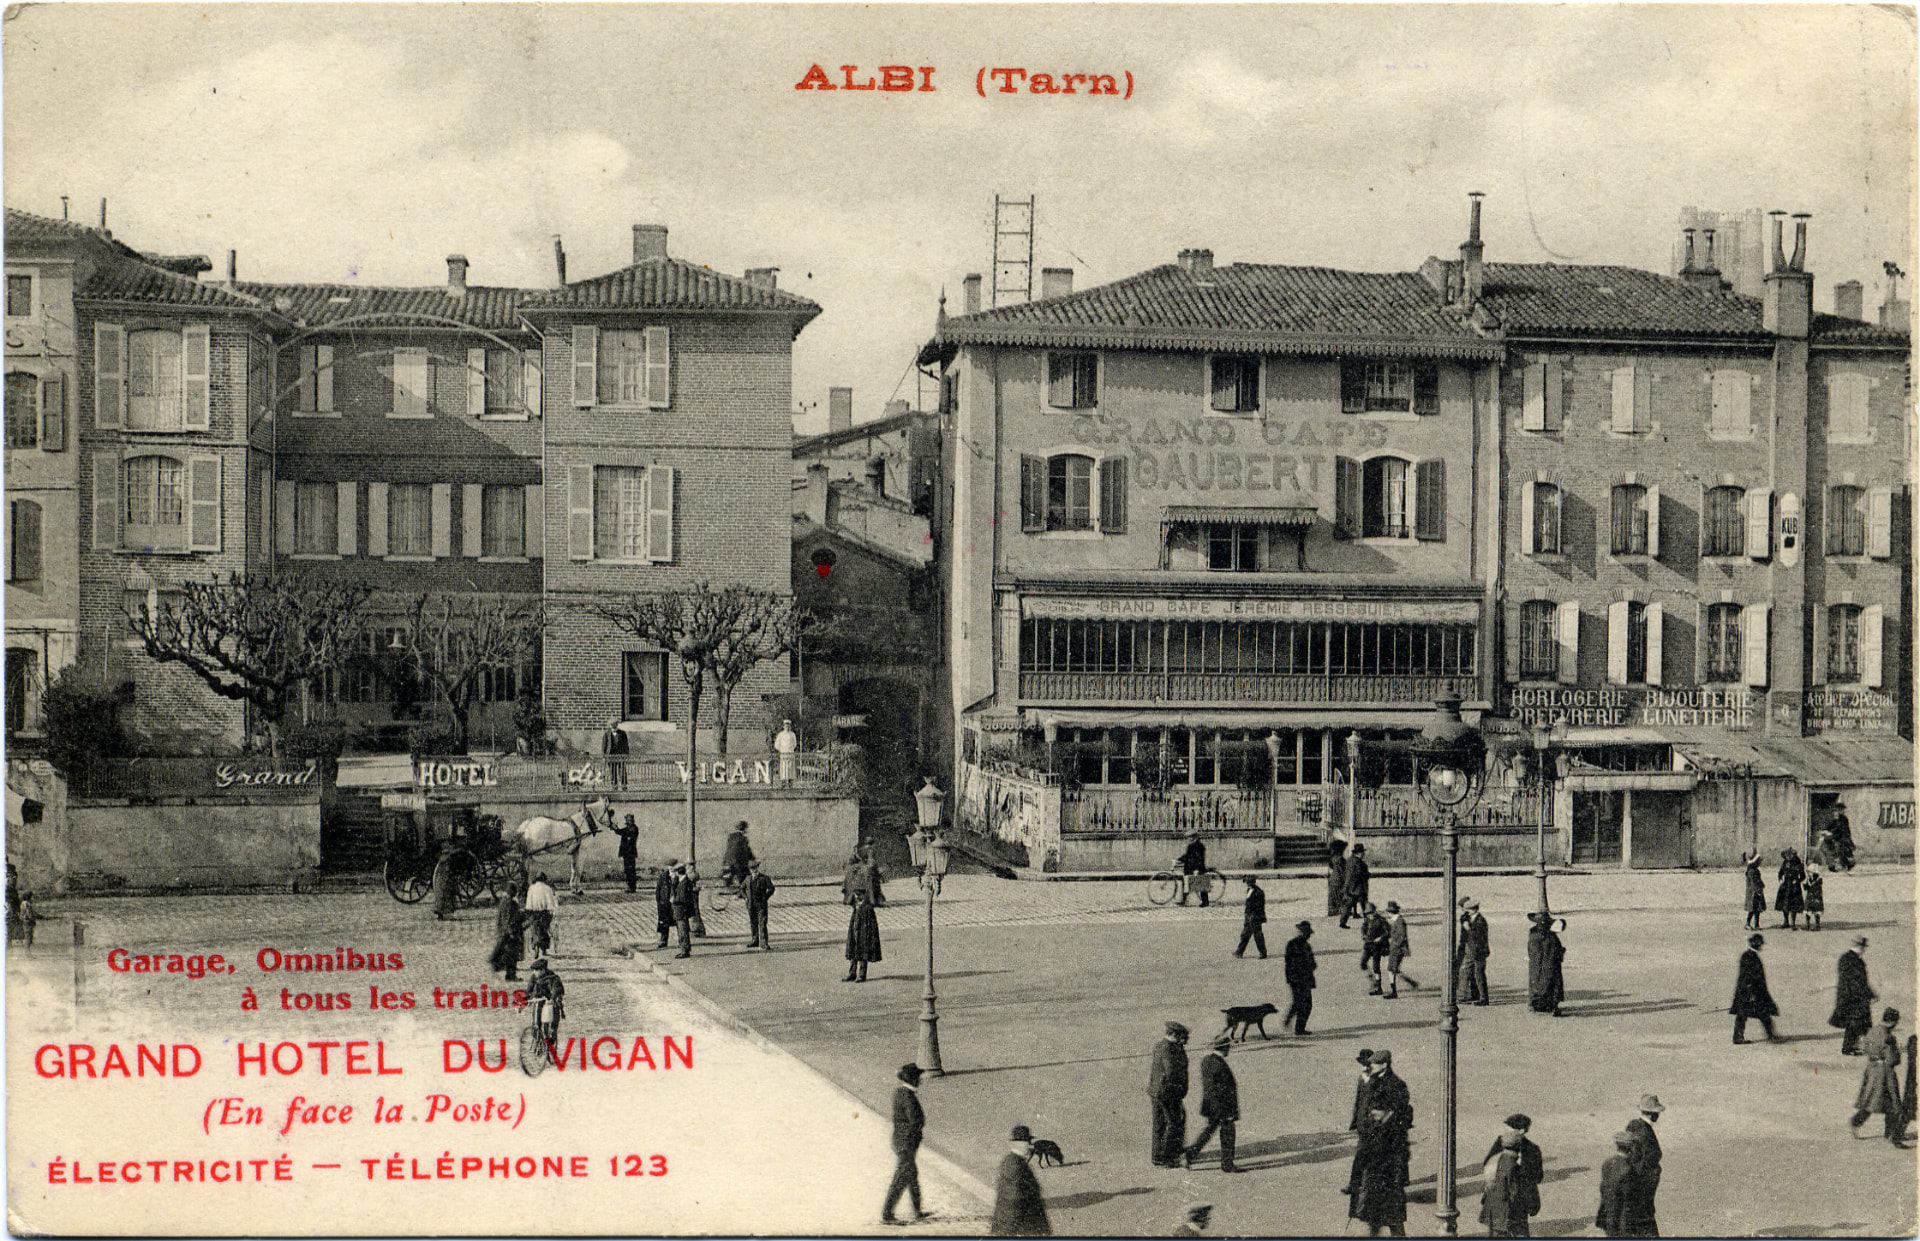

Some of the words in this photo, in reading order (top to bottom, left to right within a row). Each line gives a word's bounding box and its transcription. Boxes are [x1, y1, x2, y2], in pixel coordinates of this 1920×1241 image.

[1072, 416, 1236, 447] GRAND
[1782, 517, 1798, 535] KUB
[1099, 601, 1155, 614] GRAND
[1511, 689, 1628, 708] HORLOGERIE
[1645, 689, 1754, 709] BIJOUTERIE
[1642, 708, 1754, 727] LUNETTERIE
[216, 761, 317, 788] Grand
[419, 762, 498, 787] HOTEL
[675, 760, 773, 784] VIGAN
